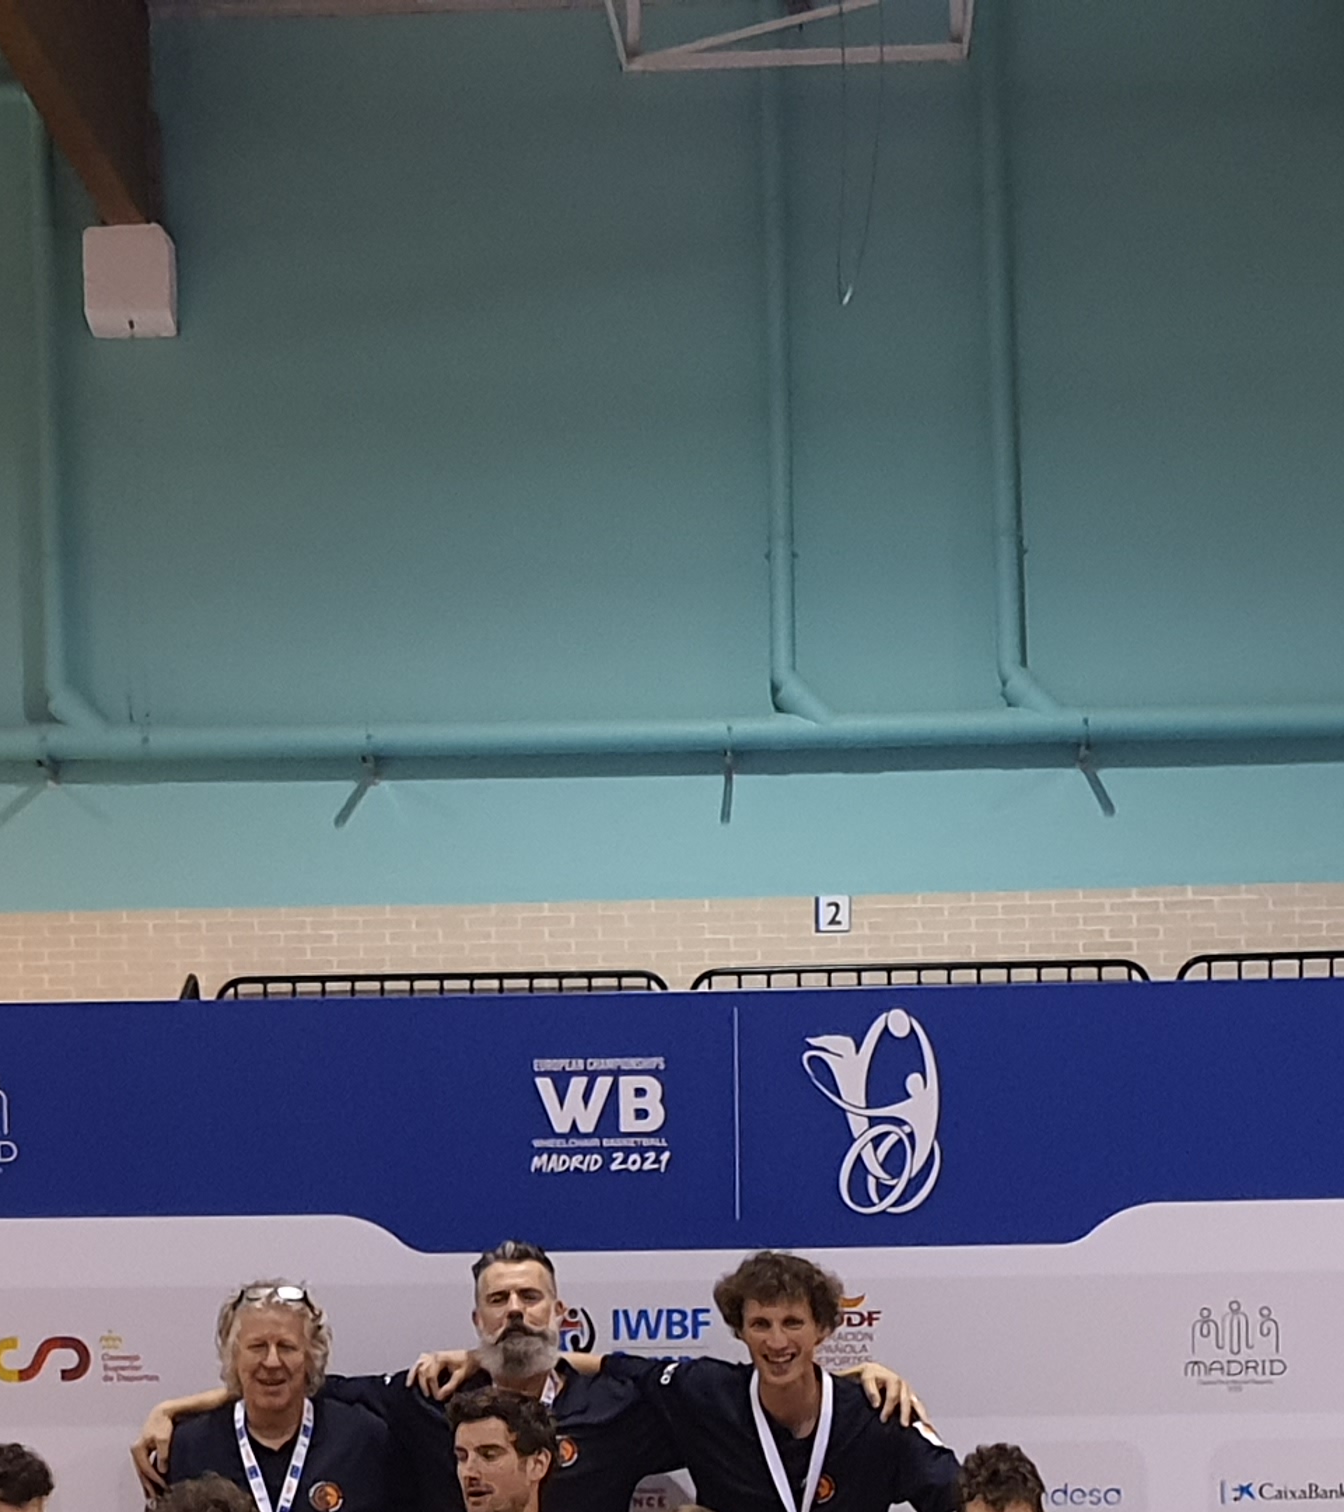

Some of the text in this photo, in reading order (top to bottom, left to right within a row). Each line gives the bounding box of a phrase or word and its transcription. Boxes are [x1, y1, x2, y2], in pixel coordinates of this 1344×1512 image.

[826, 901, 842, 926] 2
[534, 1075, 666, 1134] WB
[530, 1150, 671, 1173] MADRID 2021
[612, 1308, 711, 1340] IWBF
[1184, 1358, 1288, 1377] MADRID
[1045, 1482, 1122, 1506] desa
